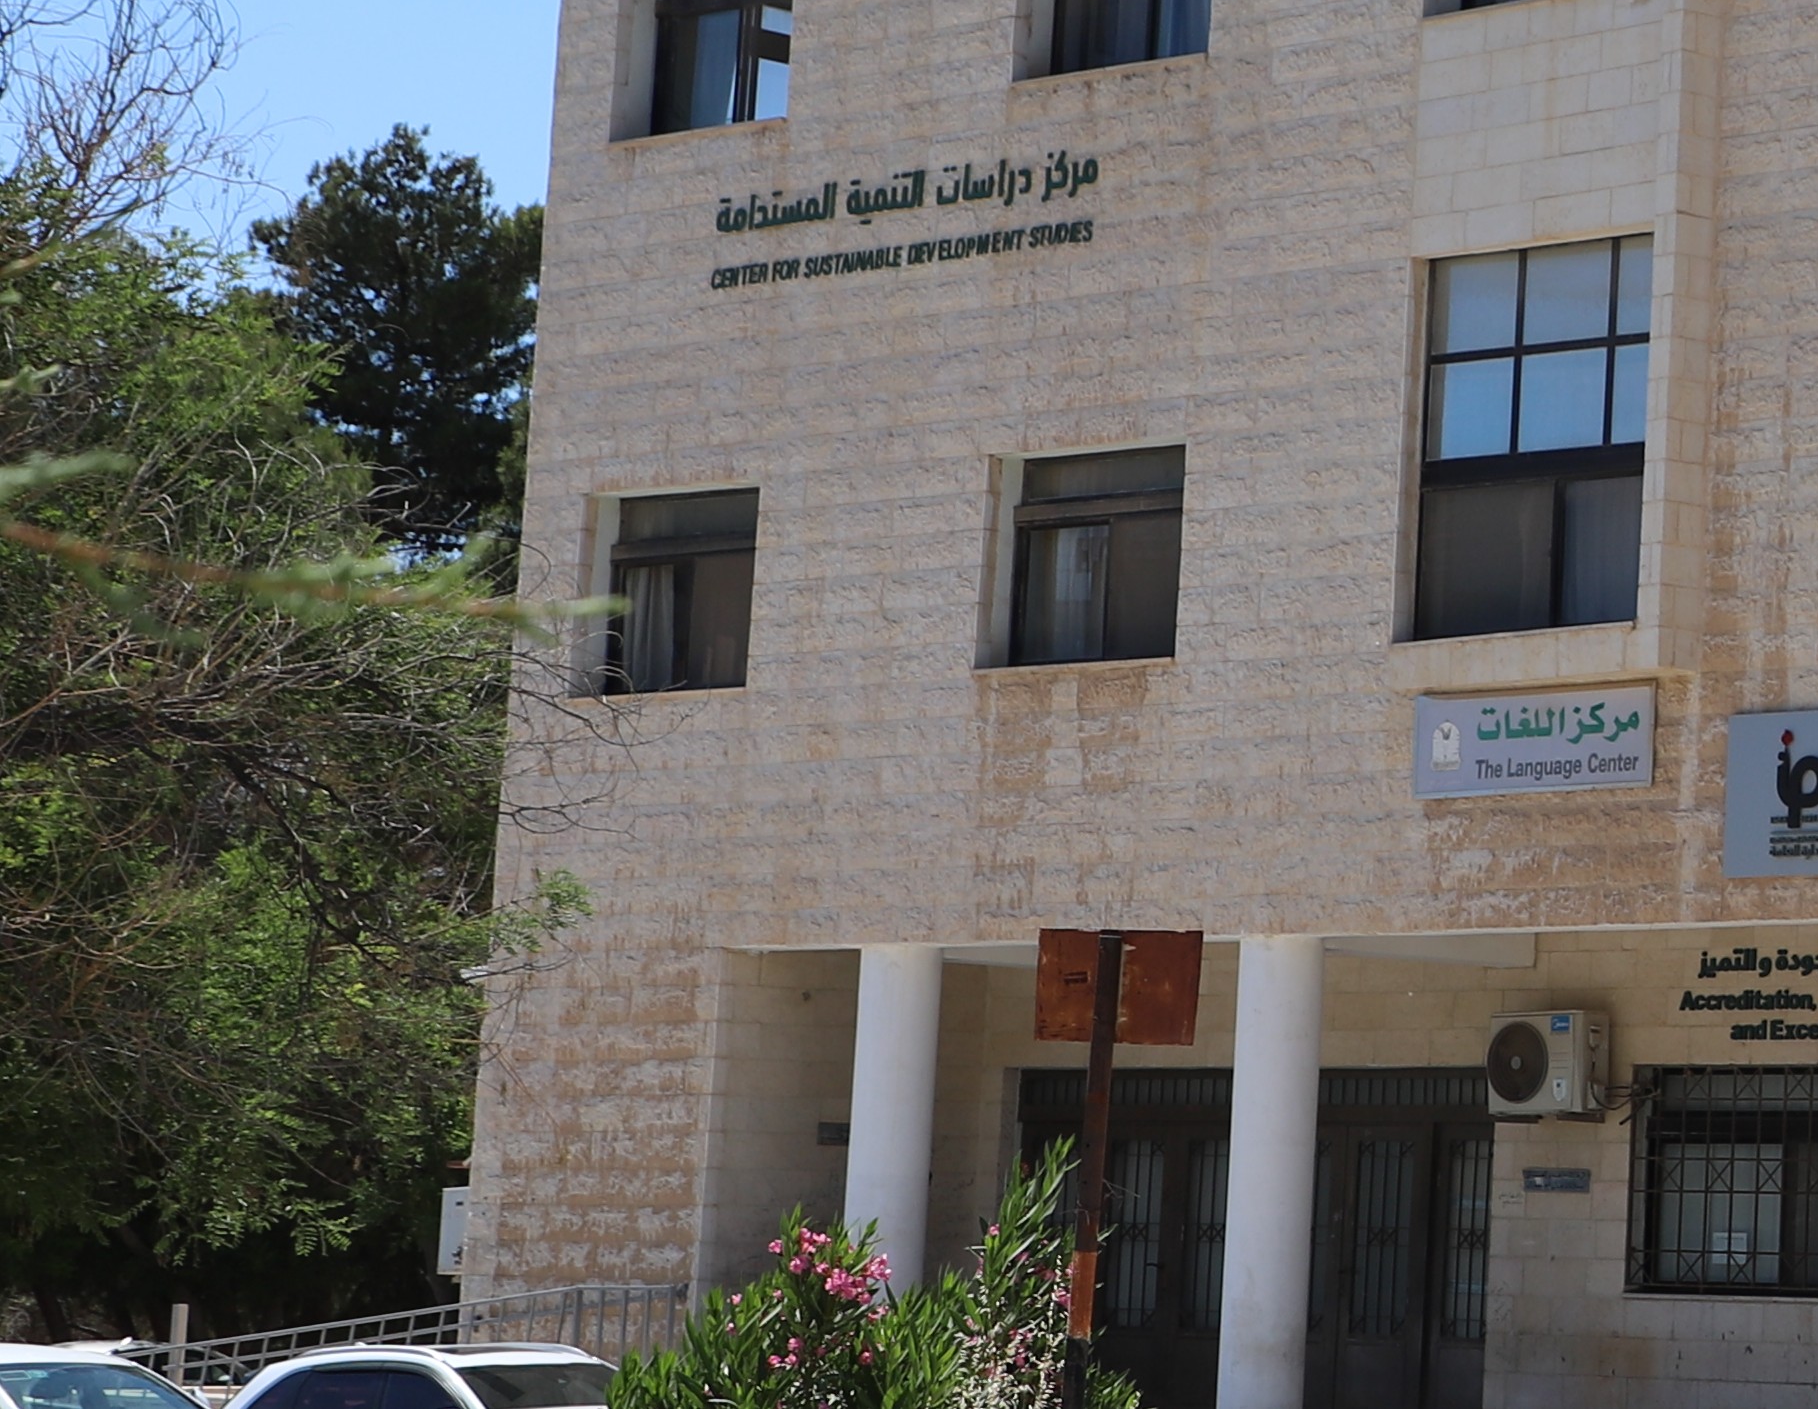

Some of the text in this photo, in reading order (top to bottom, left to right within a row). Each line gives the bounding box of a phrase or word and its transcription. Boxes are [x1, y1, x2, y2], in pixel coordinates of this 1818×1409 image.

[716, 150, 1098, 233] مركز دراسات التنمية المستدامة
[711, 220, 1093, 289] CENTER FOR SUSTAINABLE DEVELOPMENT STUDIES
[1477, 701, 1640, 744] مركز اللغات
[1475, 752, 1639, 781] The Language Center
[1679, 989, 1817, 1012] Accreditation,
[1730, 1020, 1767, 1040] and
